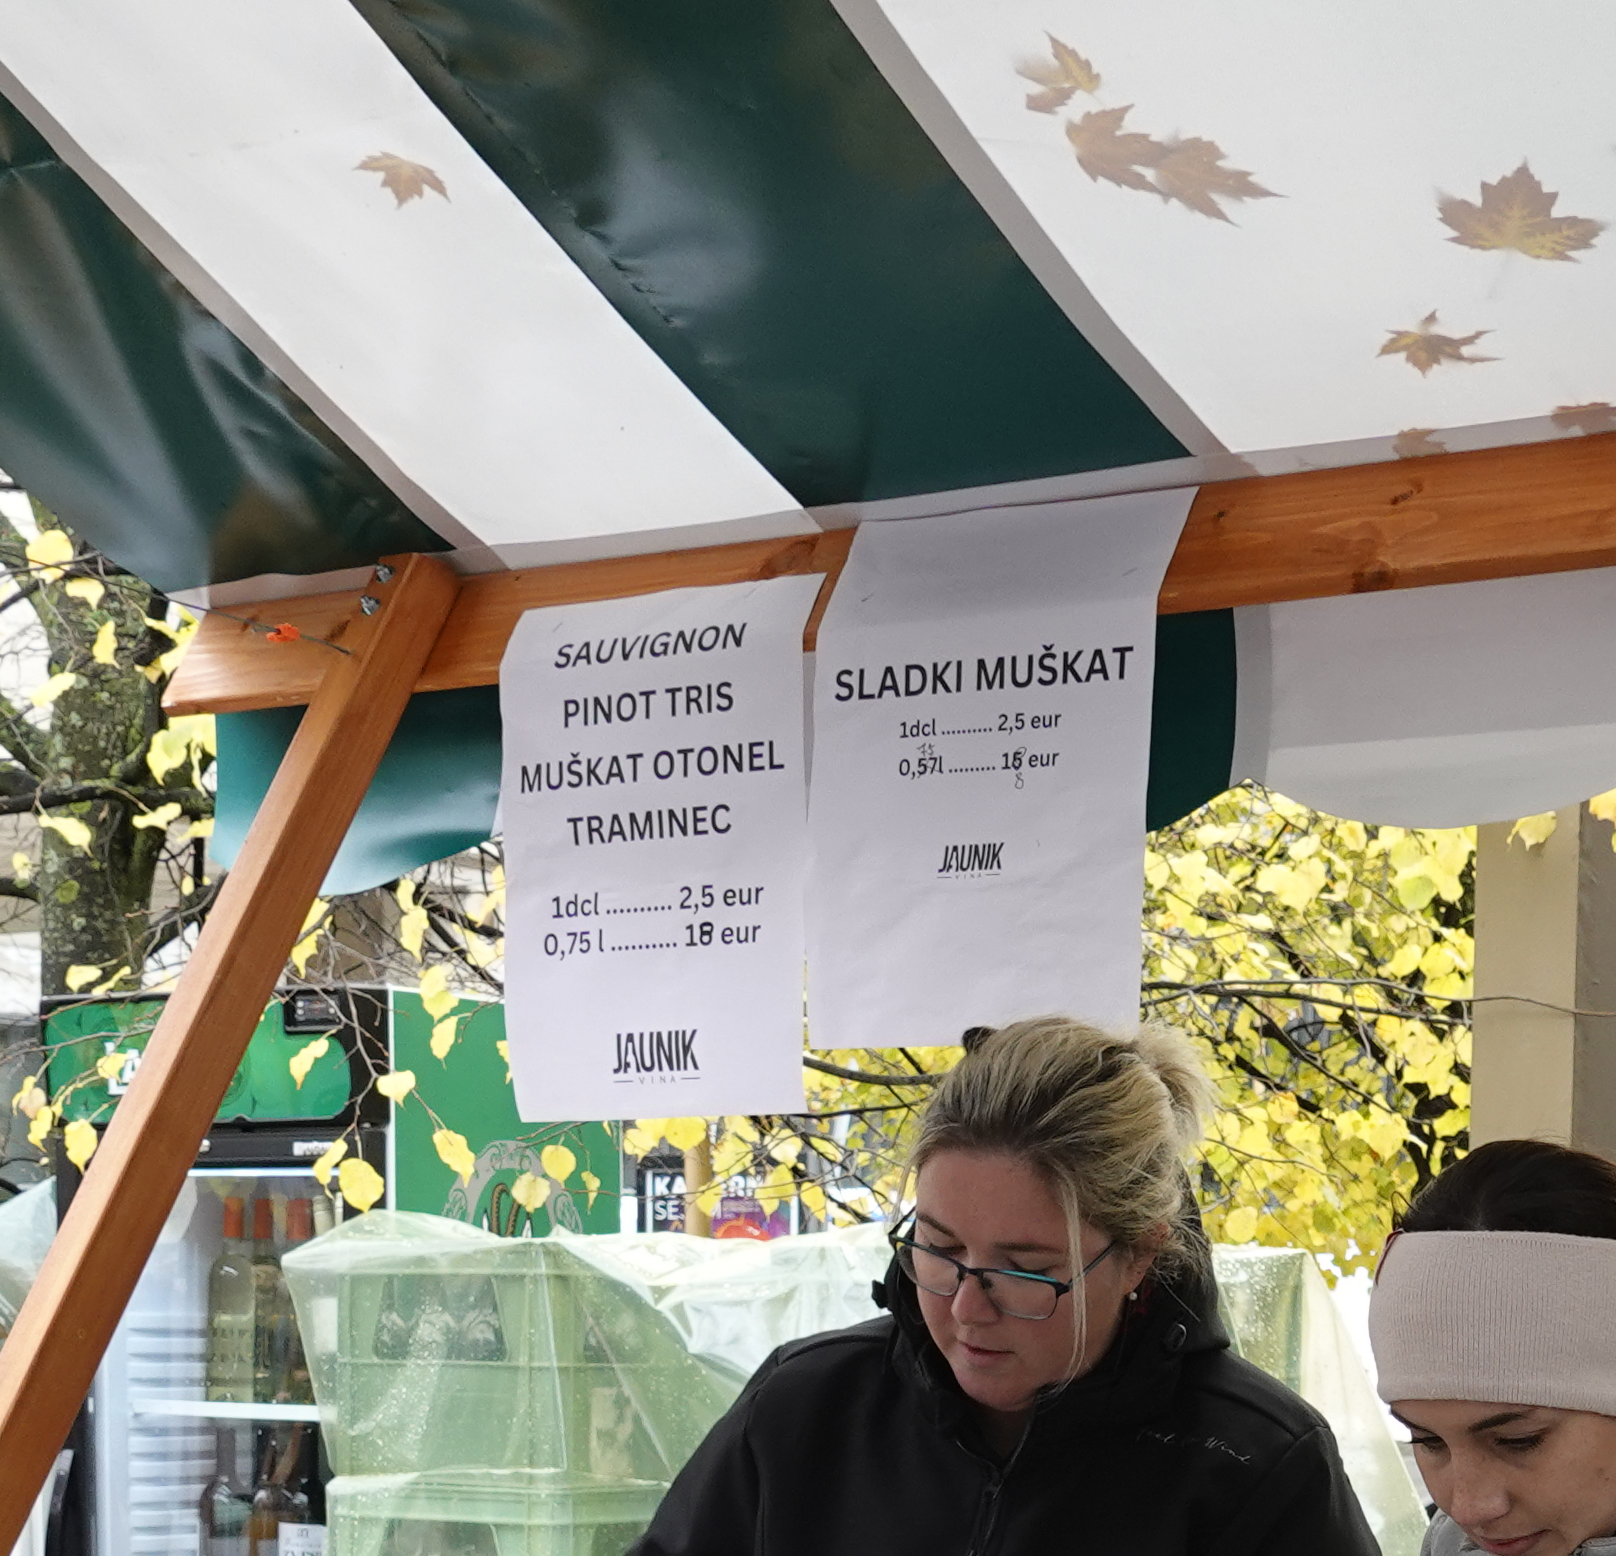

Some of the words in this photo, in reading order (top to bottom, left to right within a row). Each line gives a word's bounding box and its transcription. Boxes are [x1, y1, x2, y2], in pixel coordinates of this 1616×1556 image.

[554, 622, 747, 669] SAUVIGNON
[834, 659, 963, 702] SLADKI
[976, 643, 1134, 692] MUŠKAT
[563, 689, 657, 728] PINOT
[664, 681, 734, 717] TRIS
[899, 718, 937, 739] 1dcl
[997, 712, 1025, 735] 2,5
[1030, 713, 1062, 730] eur
[520, 752, 644, 794] MUŠKAT
[653, 740, 785, 780] OTONEL
[1028, 752, 1060, 768] eur
[566, 803, 732, 846] TRAMINEC
[938, 842, 1005, 873] JAUNIK
[551, 891, 600, 919] 1dcl
[679, 884, 715, 915] 2,5
[722, 886, 765, 907] eur
[543, 930, 591, 961] 0,75
[720, 924, 762, 945] eur
[612, 1028, 700, 1075] JAUNIK
[638, 1074, 677, 1085] VINA
